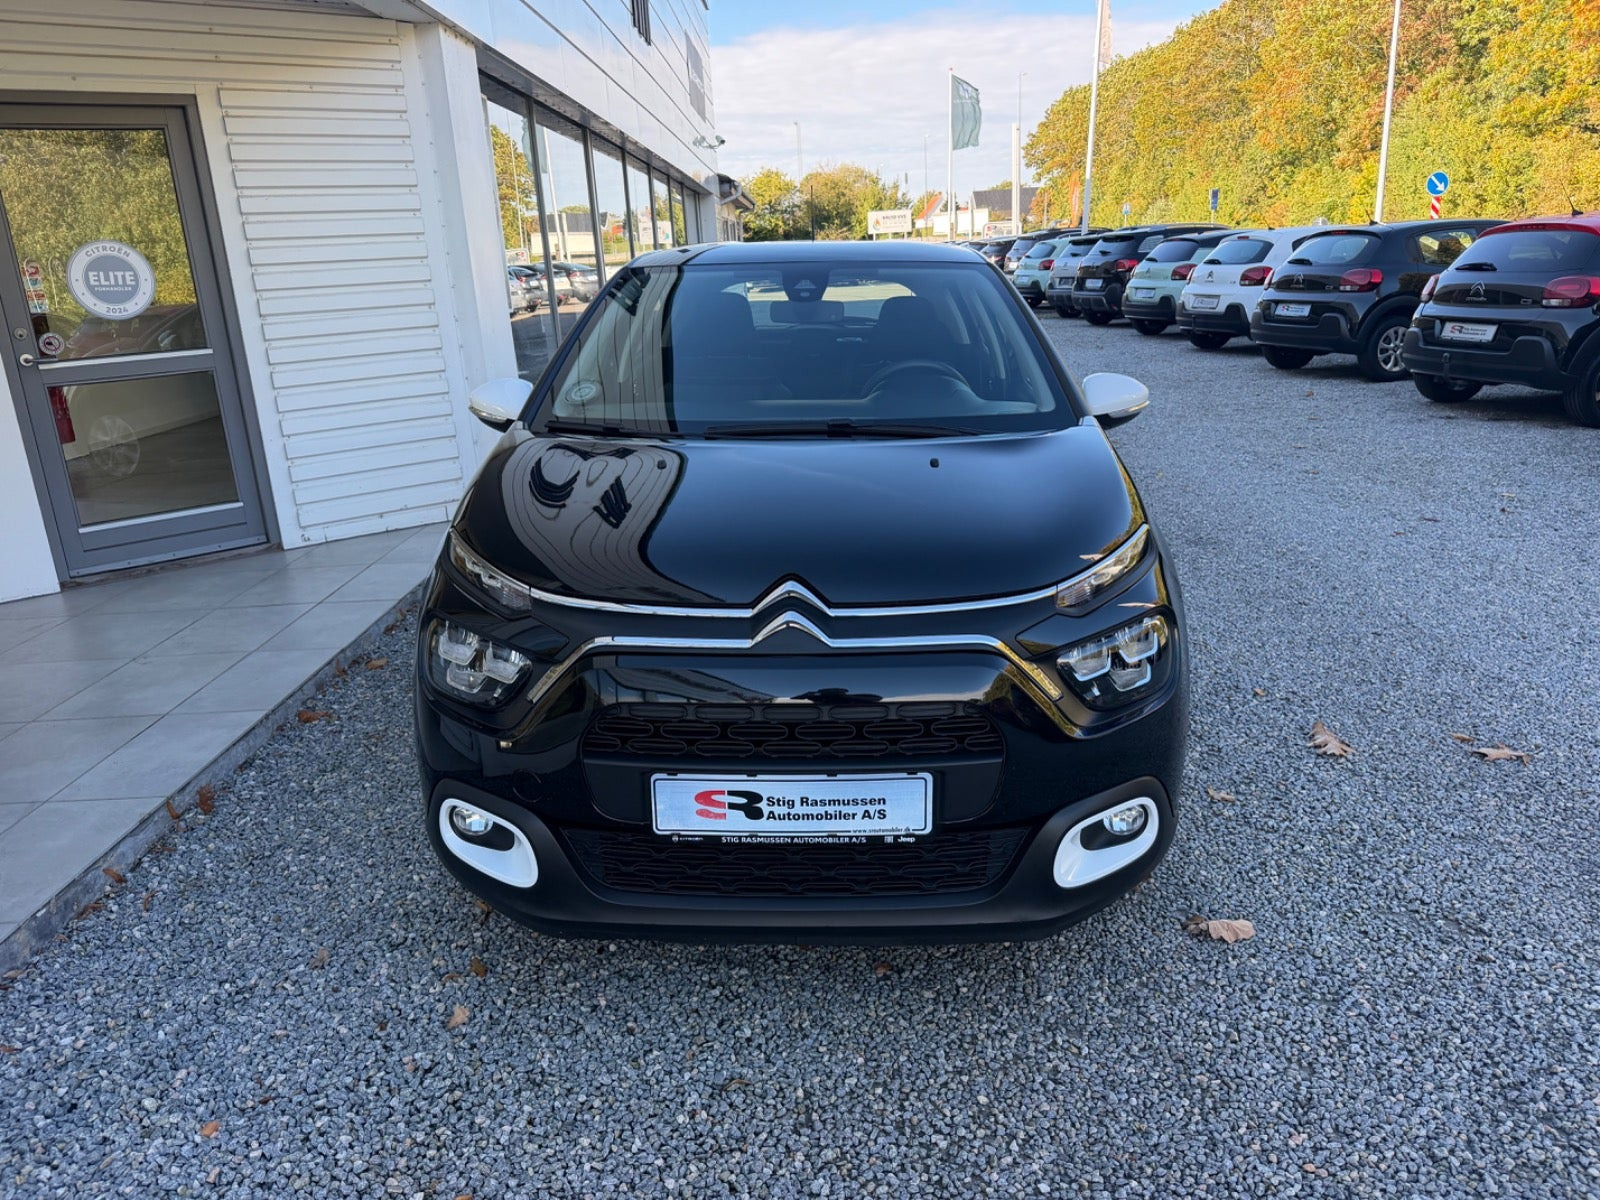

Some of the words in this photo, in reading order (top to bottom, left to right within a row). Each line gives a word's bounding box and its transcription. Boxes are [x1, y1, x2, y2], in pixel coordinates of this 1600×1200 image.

[85, 245, 131, 258] CITROËN
[88, 271, 136, 286] ELITE
[766, 796, 794, 808] Stig
[800, 797, 886, 807] Rasmussen
[766, 810, 858, 821] Automobiler
[861, 809, 887, 820] A/S
